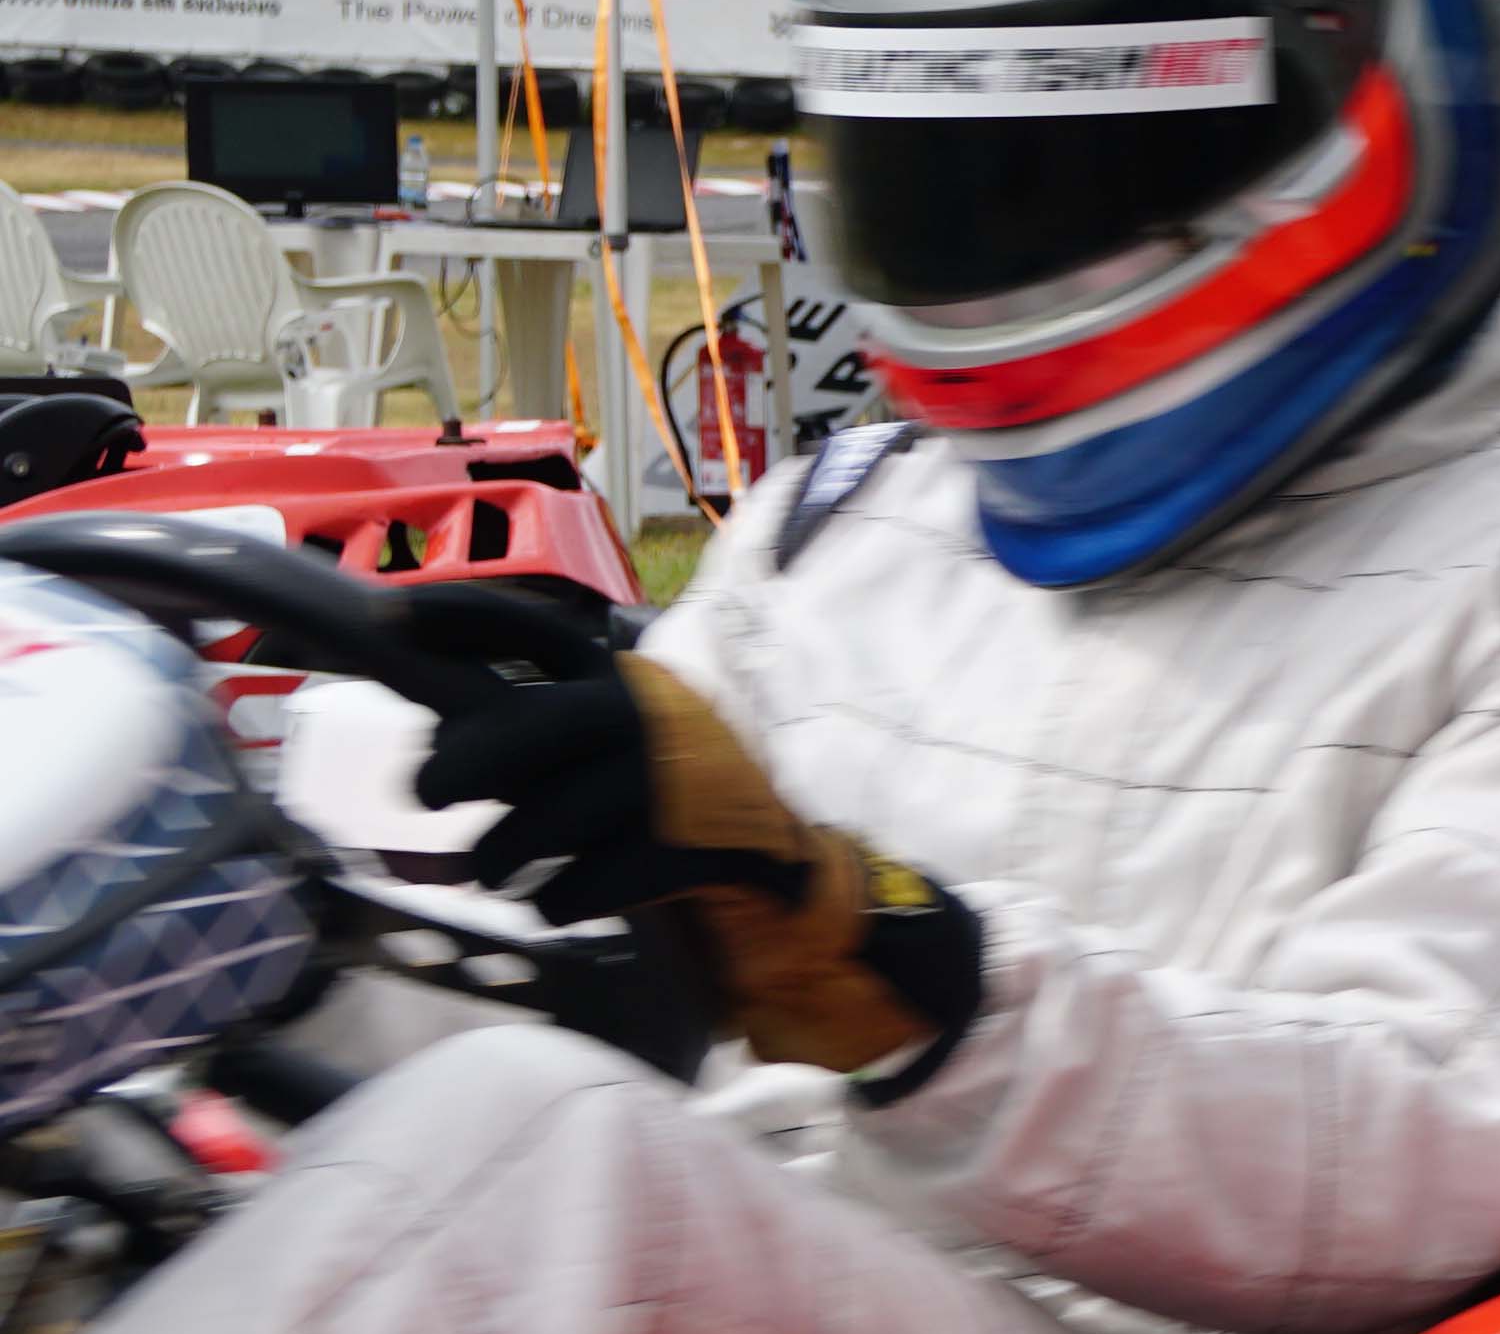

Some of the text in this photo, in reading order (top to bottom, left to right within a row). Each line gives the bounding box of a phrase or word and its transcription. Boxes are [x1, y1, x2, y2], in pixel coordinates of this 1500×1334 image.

[338, 0, 392, 22] The
[403, 1, 480, 25] Powe
[543, 9, 657, 36] Drems
